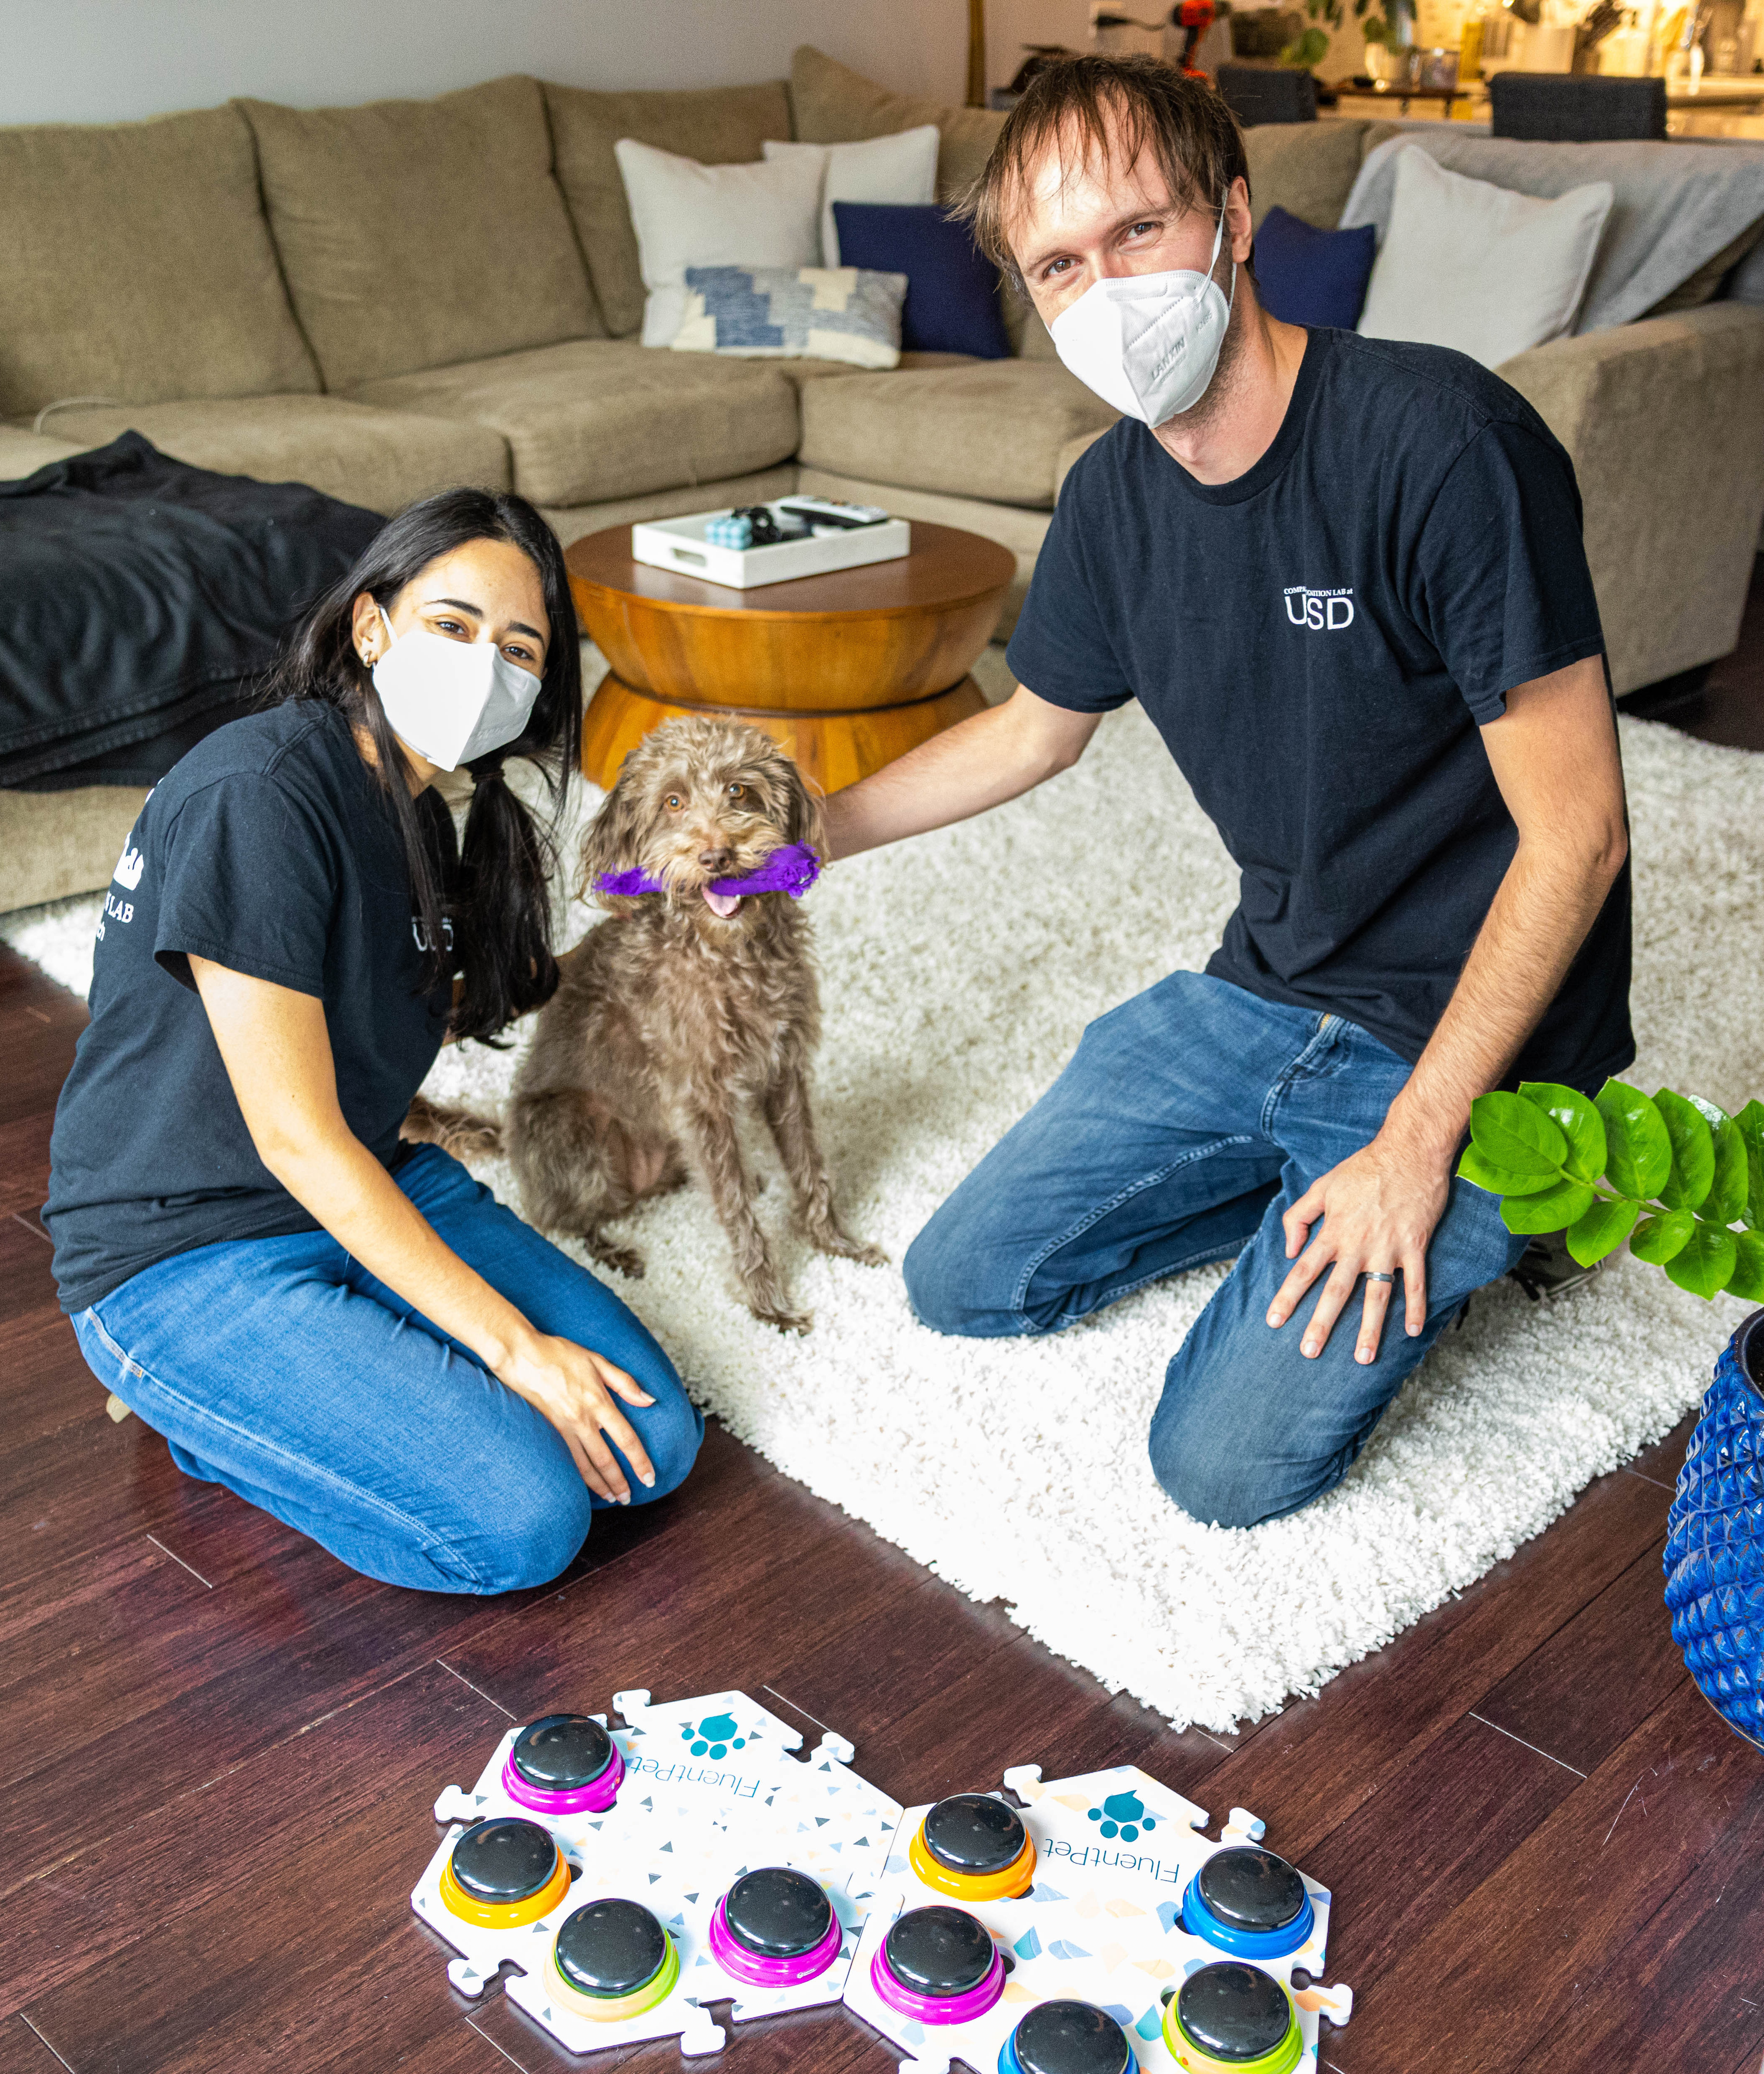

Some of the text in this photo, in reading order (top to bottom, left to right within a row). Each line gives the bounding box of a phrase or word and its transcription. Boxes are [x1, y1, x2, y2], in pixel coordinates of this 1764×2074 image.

[1284, 594, 1354, 630] USD
[108, 895, 134, 923] LAB
[630, 1756, 760, 1798] FluentPet
[1043, 1838, 1179, 1883] FluentPet
